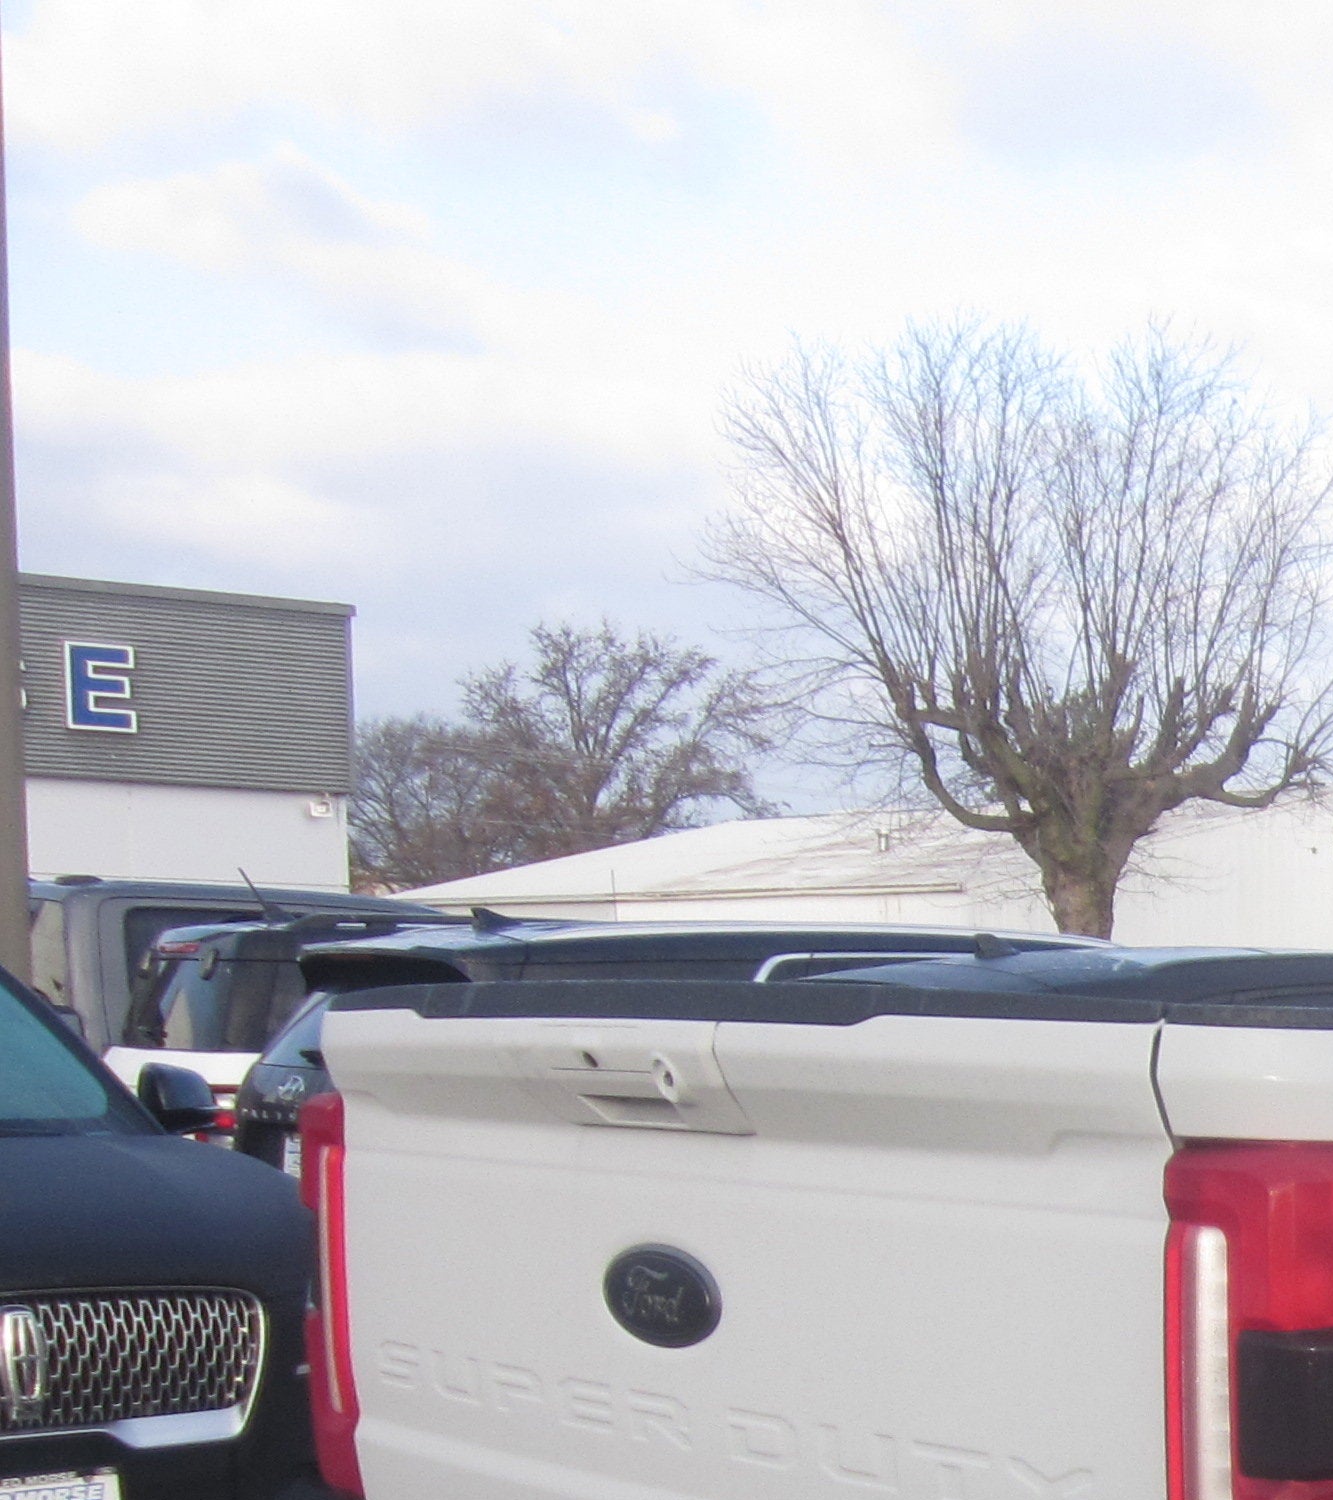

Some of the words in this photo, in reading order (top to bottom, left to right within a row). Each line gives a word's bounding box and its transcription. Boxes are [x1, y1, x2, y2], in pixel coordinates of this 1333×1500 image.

[20, 640, 138, 734] E
[623, 1264, 684, 1323] Ford
[379, 1339, 692, 1449] SUPER
